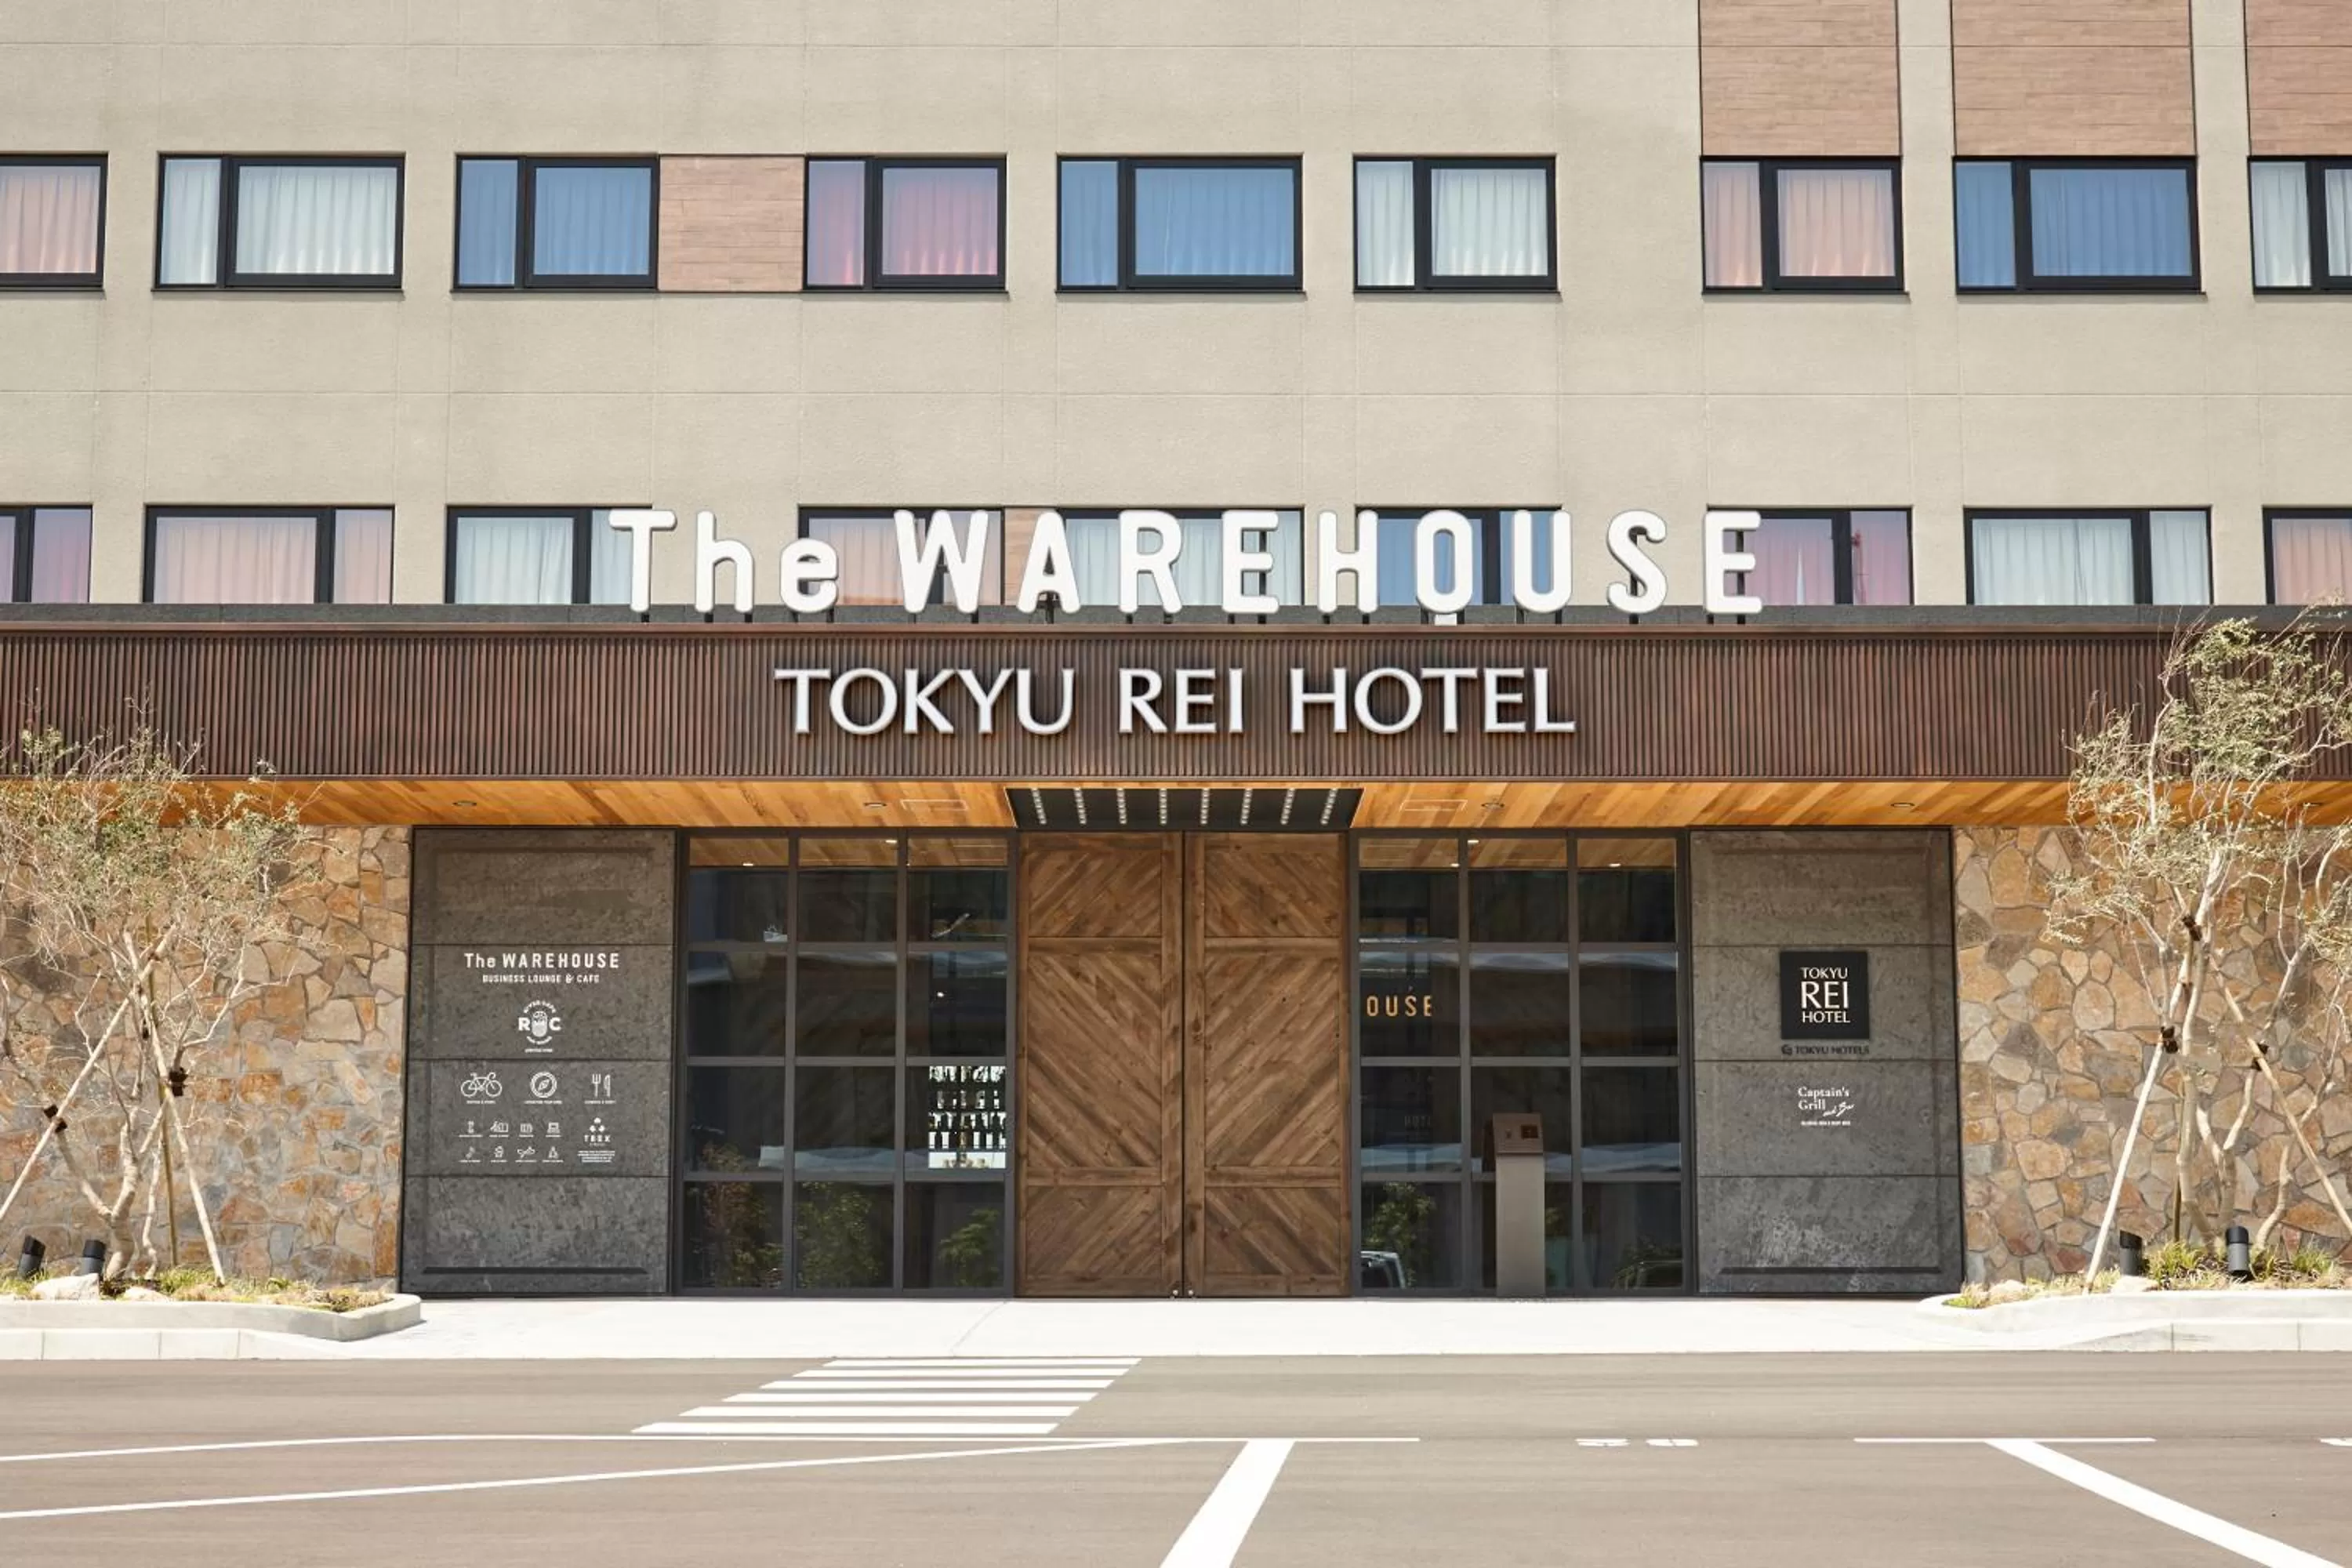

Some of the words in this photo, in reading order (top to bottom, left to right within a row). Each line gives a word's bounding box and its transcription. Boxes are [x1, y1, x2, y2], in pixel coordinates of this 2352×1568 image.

[609, 510, 839, 614] The
[894, 509, 1763, 614] WAREHOUSE
[774, 667, 1075, 735] TOKYU
[1118, 668, 1243, 734] REI
[1290, 667, 1576, 735] HOTEL
[464, 953, 496, 968] The
[503, 953, 619, 969] WAREHOUSE
[482, 975, 525, 984] BUSINESS
[528, 975, 561, 984] LOUNGE
[576, 975, 600, 984] CAFE
[1801, 967, 1849, 979] TOKYU
[1801, 981, 1849, 1010] REI
[1802, 1011, 1851, 1024] HOTEL
[1795, 1044, 1830, 1055] TOKYU
[1831, 1044, 1870, 1055] HOTELS
[1798, 1086, 1849, 1102] Captain's
[1798, 1098, 1826, 1111] Grill
